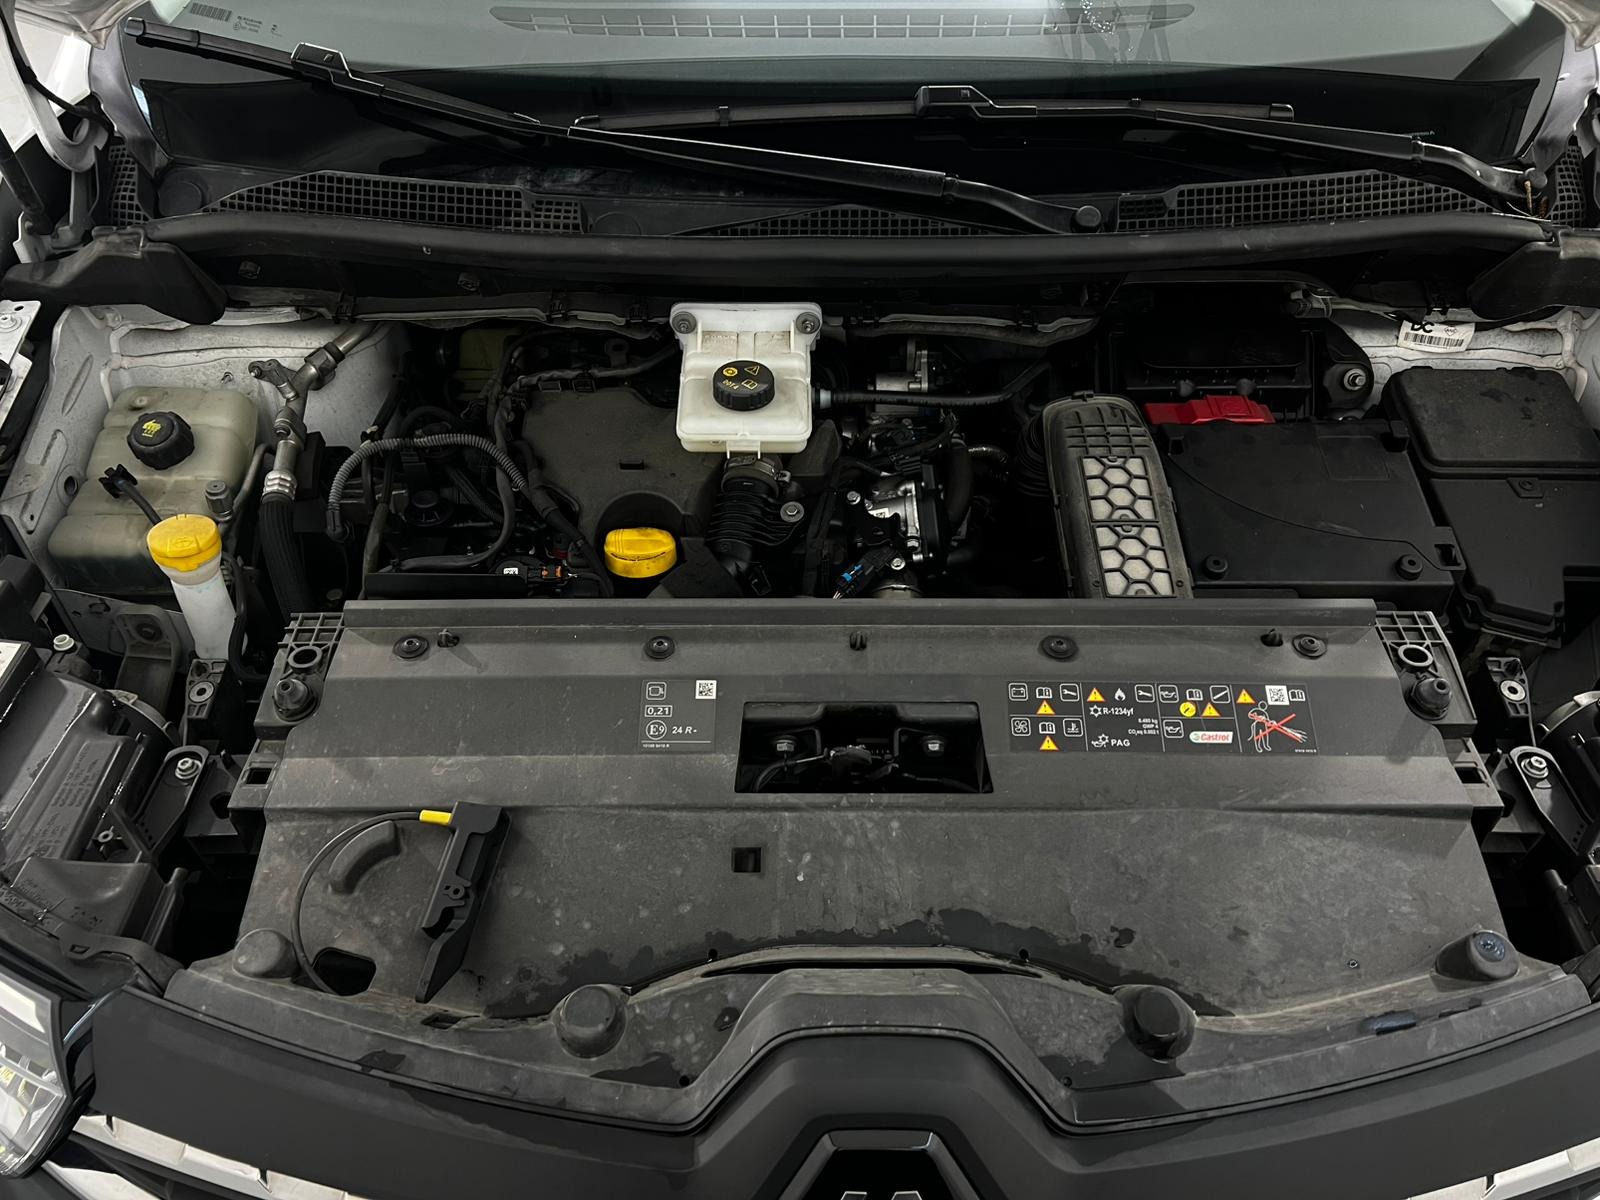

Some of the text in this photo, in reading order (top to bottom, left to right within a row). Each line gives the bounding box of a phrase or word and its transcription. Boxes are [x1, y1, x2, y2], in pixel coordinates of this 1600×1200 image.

[1103, 707, 1134, 717] R-1234yf
[1201, 733, 1229, 741] Castrol
[1111, 739, 1130, 747] PAG
